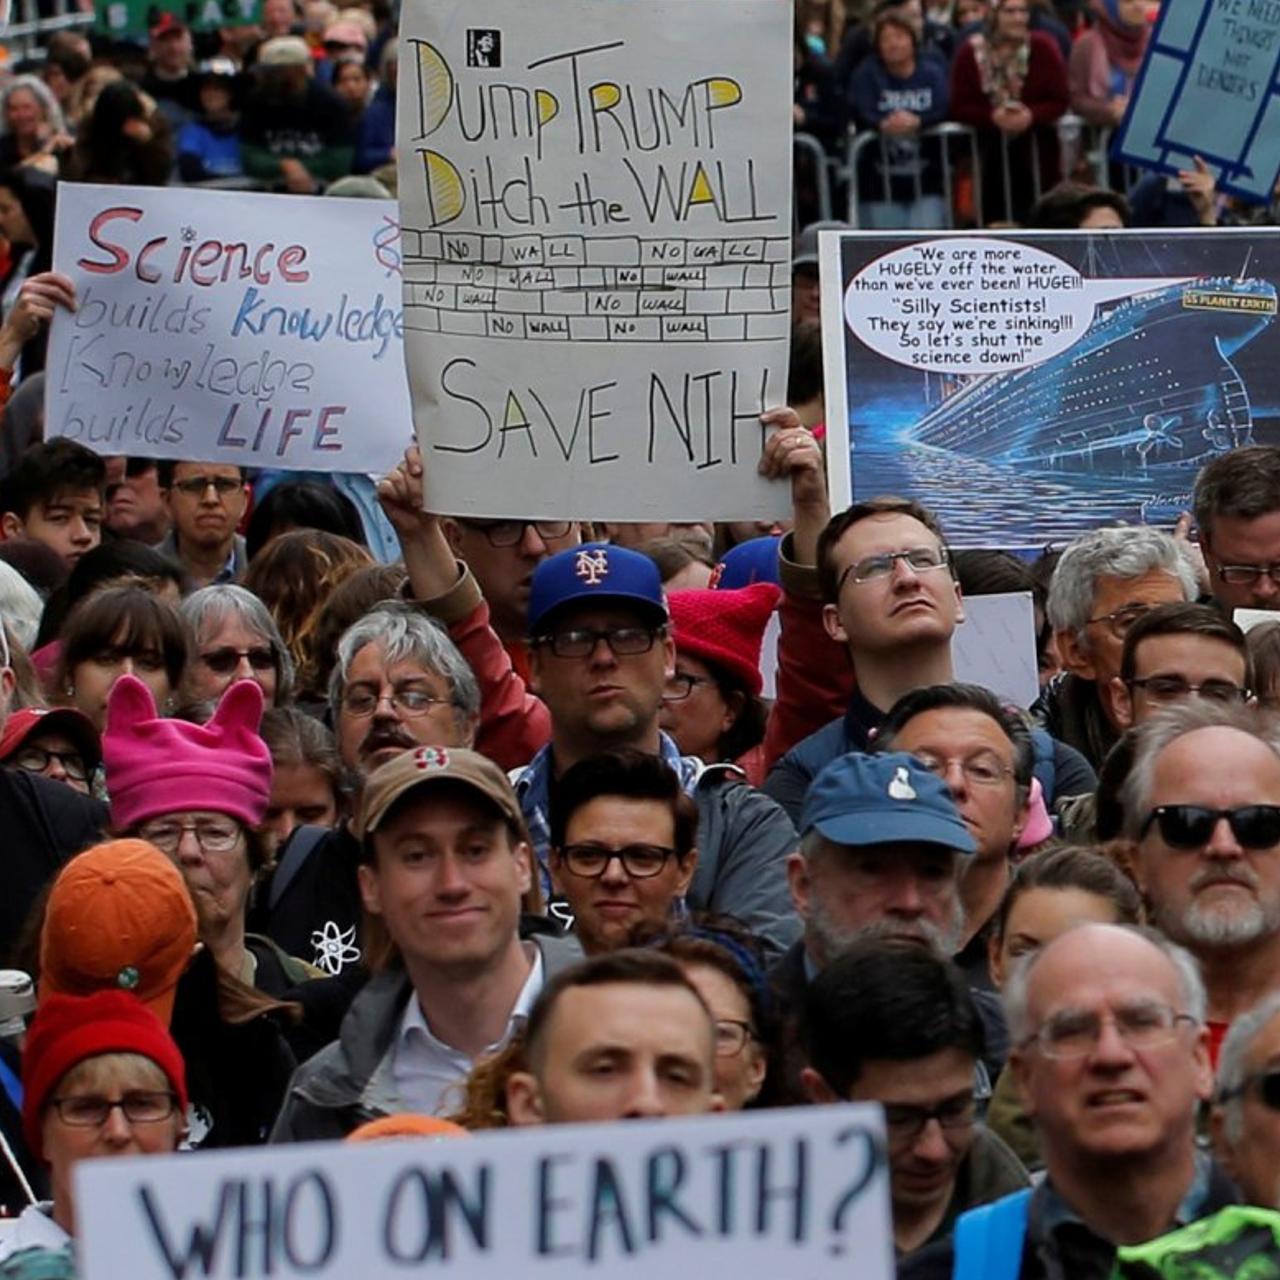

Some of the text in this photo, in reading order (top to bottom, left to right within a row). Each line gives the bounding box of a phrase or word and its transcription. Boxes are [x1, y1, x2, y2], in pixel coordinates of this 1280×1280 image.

[407, 38, 743, 161] Dump TRUMP
[415, 147, 777, 229] Ditch the WALL
[77, 206, 310, 287] Science
[446, 240, 470, 257] NO
[511, 245, 576, 261] WALL
[651, 243, 681, 259] NO
[952, 249, 977, 260] are
[984, 248, 1022, 260] more
[462, 268, 484, 281] NO
[618, 270, 639, 283] NO
[665, 270, 706, 283] WALL
[879, 261, 1057, 276] HUGELY off the water
[855, 275, 1084, 291] than we've ever been! HUGE!!!
[74, 286, 211, 336] builds
[424, 289, 685, 312] NO WALL NO WALL
[950, 296, 1047, 314] Scientists!
[493, 318, 707, 334] NO WALL NO WALL
[867, 315, 1073, 335] They say we're sinking!!!
[898, 332, 1043, 348] So let's shut the
[911, 349, 976, 365] science
[59, 333, 314, 408] Knowledge
[434, 357, 768, 470] SAVE NIH
[61, 399, 347, 457] builds LIFE
[381, 1162, 494, 1267] ON
[535, 1126, 885, 1264] EARTH?
